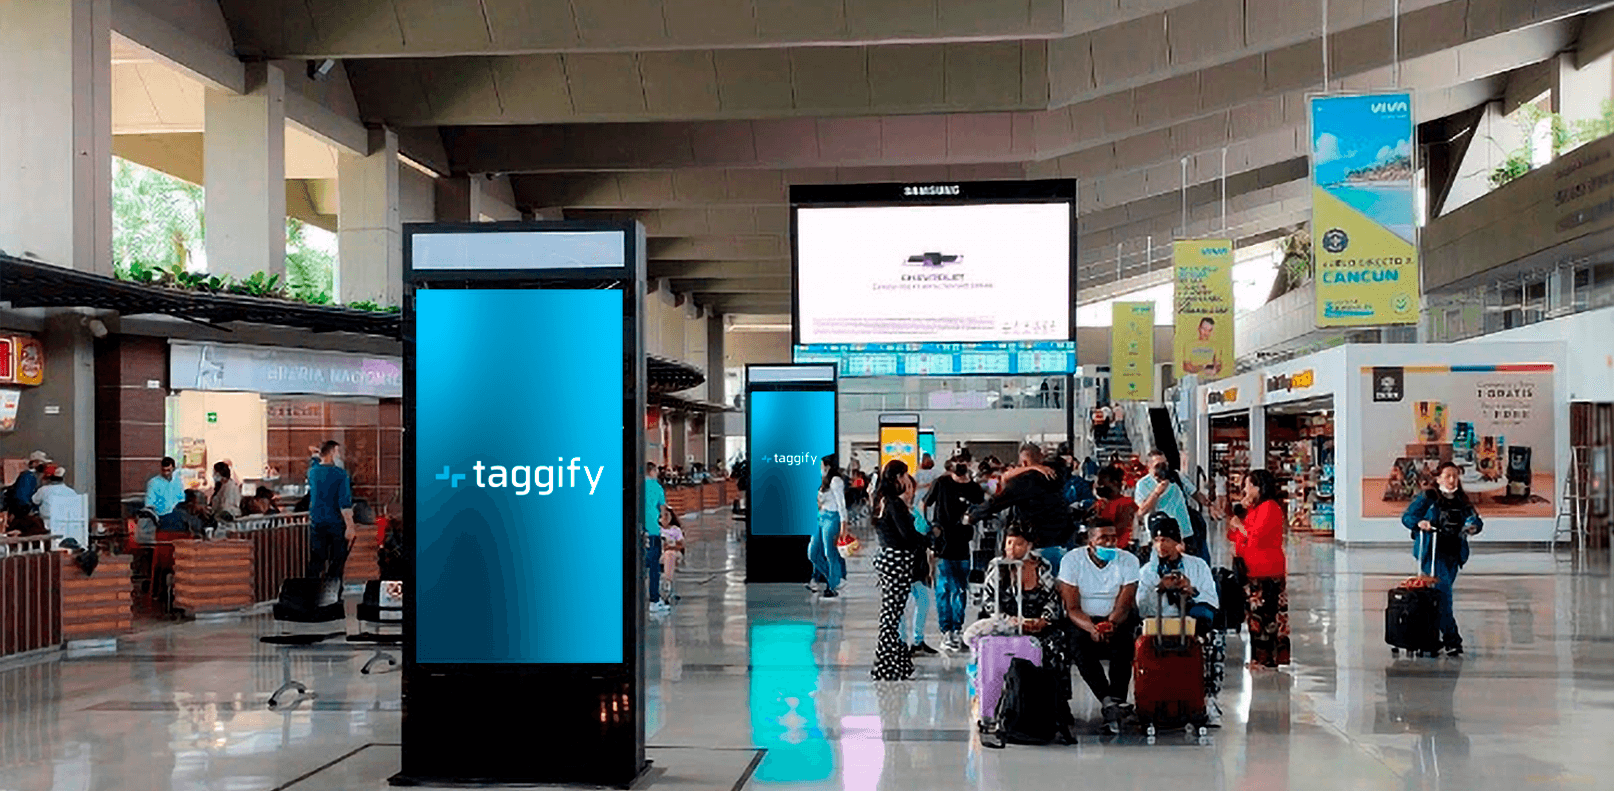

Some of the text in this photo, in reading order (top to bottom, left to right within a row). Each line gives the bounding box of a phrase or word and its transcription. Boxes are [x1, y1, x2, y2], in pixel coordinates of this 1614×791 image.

[1371, 101, 1407, 113] VIVA
[903, 185, 960, 196] SAMSUNG
[1323, 269, 1399, 283] CANCUN
[773, 451, 818, 466] taggify
[472, 456, 605, 496] taggify
